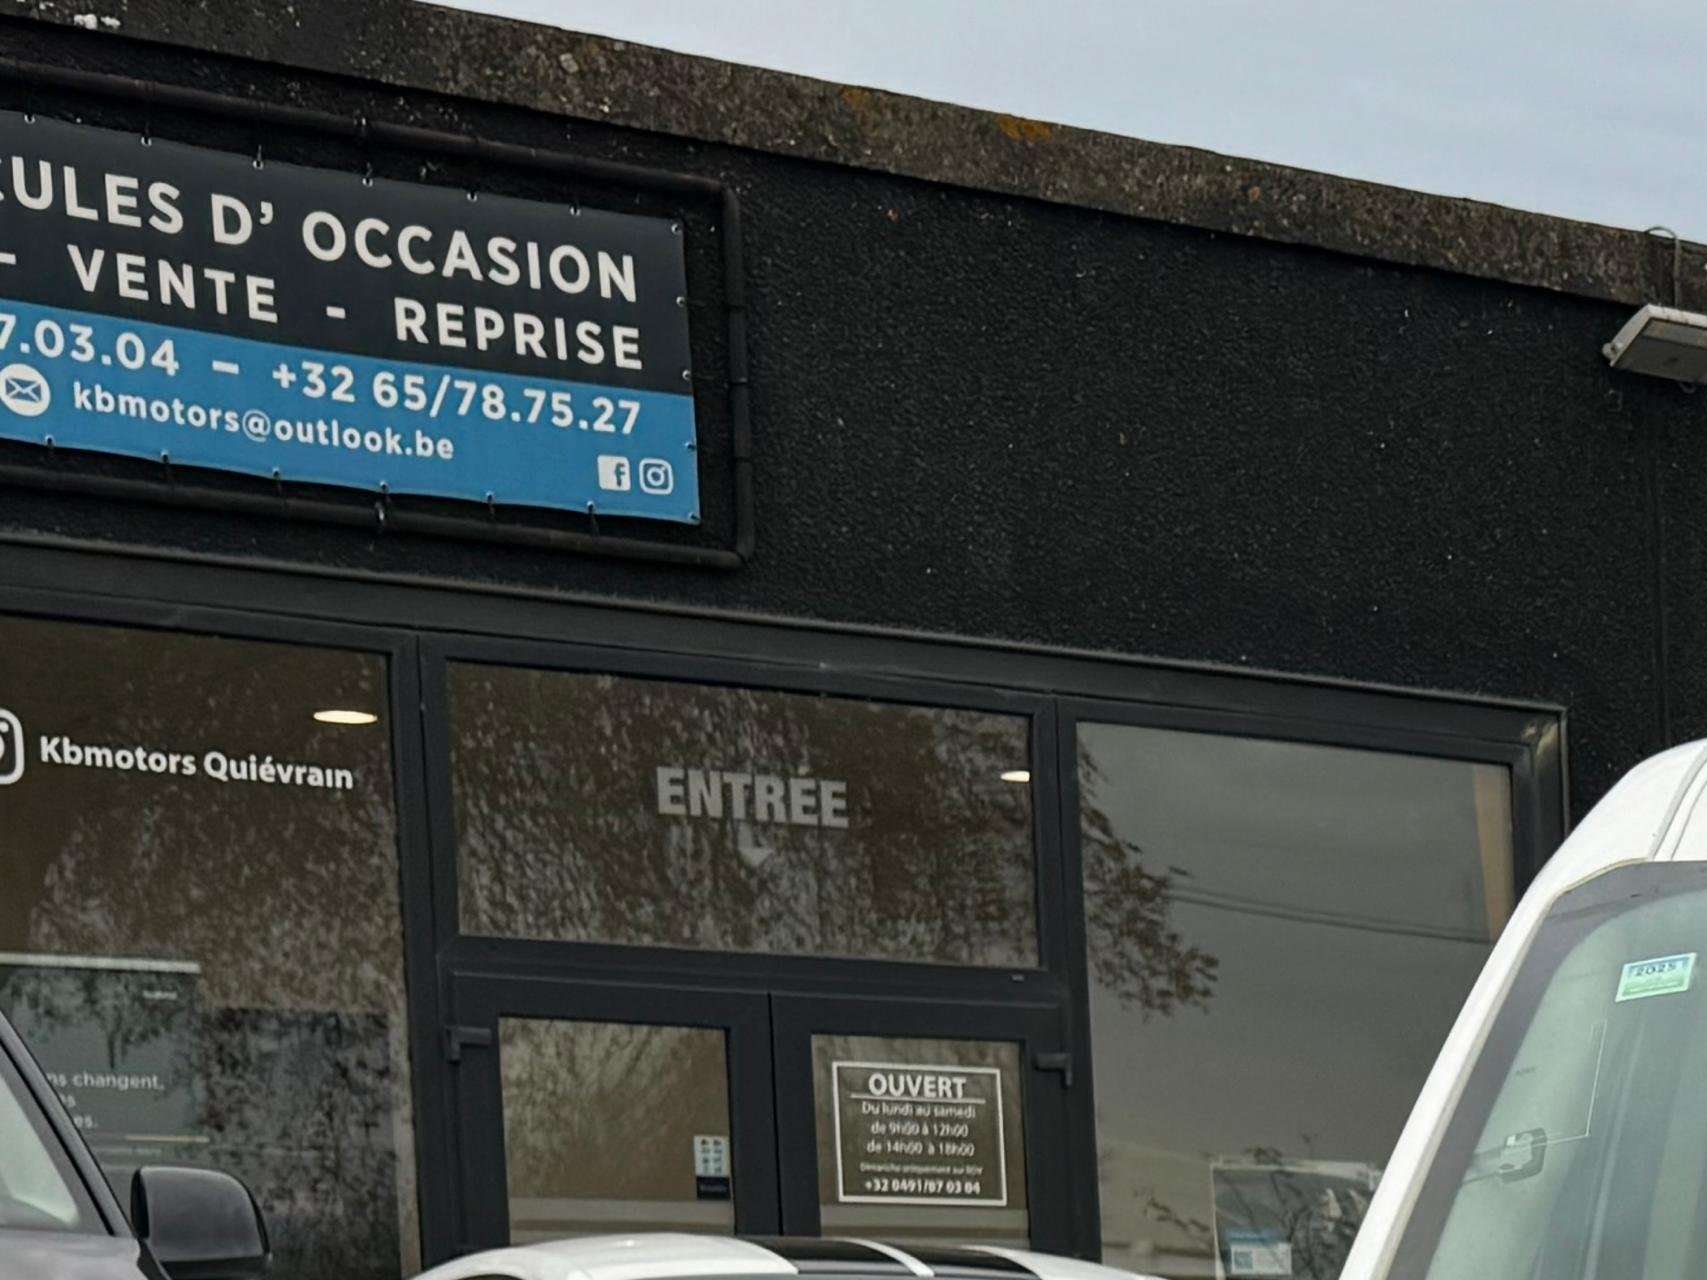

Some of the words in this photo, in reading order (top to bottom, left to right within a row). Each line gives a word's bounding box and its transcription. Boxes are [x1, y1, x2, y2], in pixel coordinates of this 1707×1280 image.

[0, 156, 184, 234] ULES
[302, 210, 637, 303] OCCASION
[67, 243, 279, 324] VENTE
[394, 296, 643, 371] REPRISE
[73, 380, 455, 460] kbmotors@outlook.be
[272, 360, 356, 403] +32
[372, 371, 641, 435] 65/78.75.27
[40, 735, 197, 776] Kbmotors
[203, 750, 354, 790] Quiévrain
[862, 1101, 880, 1115] Du
[882, 1101, 913, 1116] lundi
[933, 1104, 976, 1119] samedi
[868, 1072, 967, 1099] OUVERT
[866, 1138, 882, 1154] de
[870, 1120, 886, 1134] de
